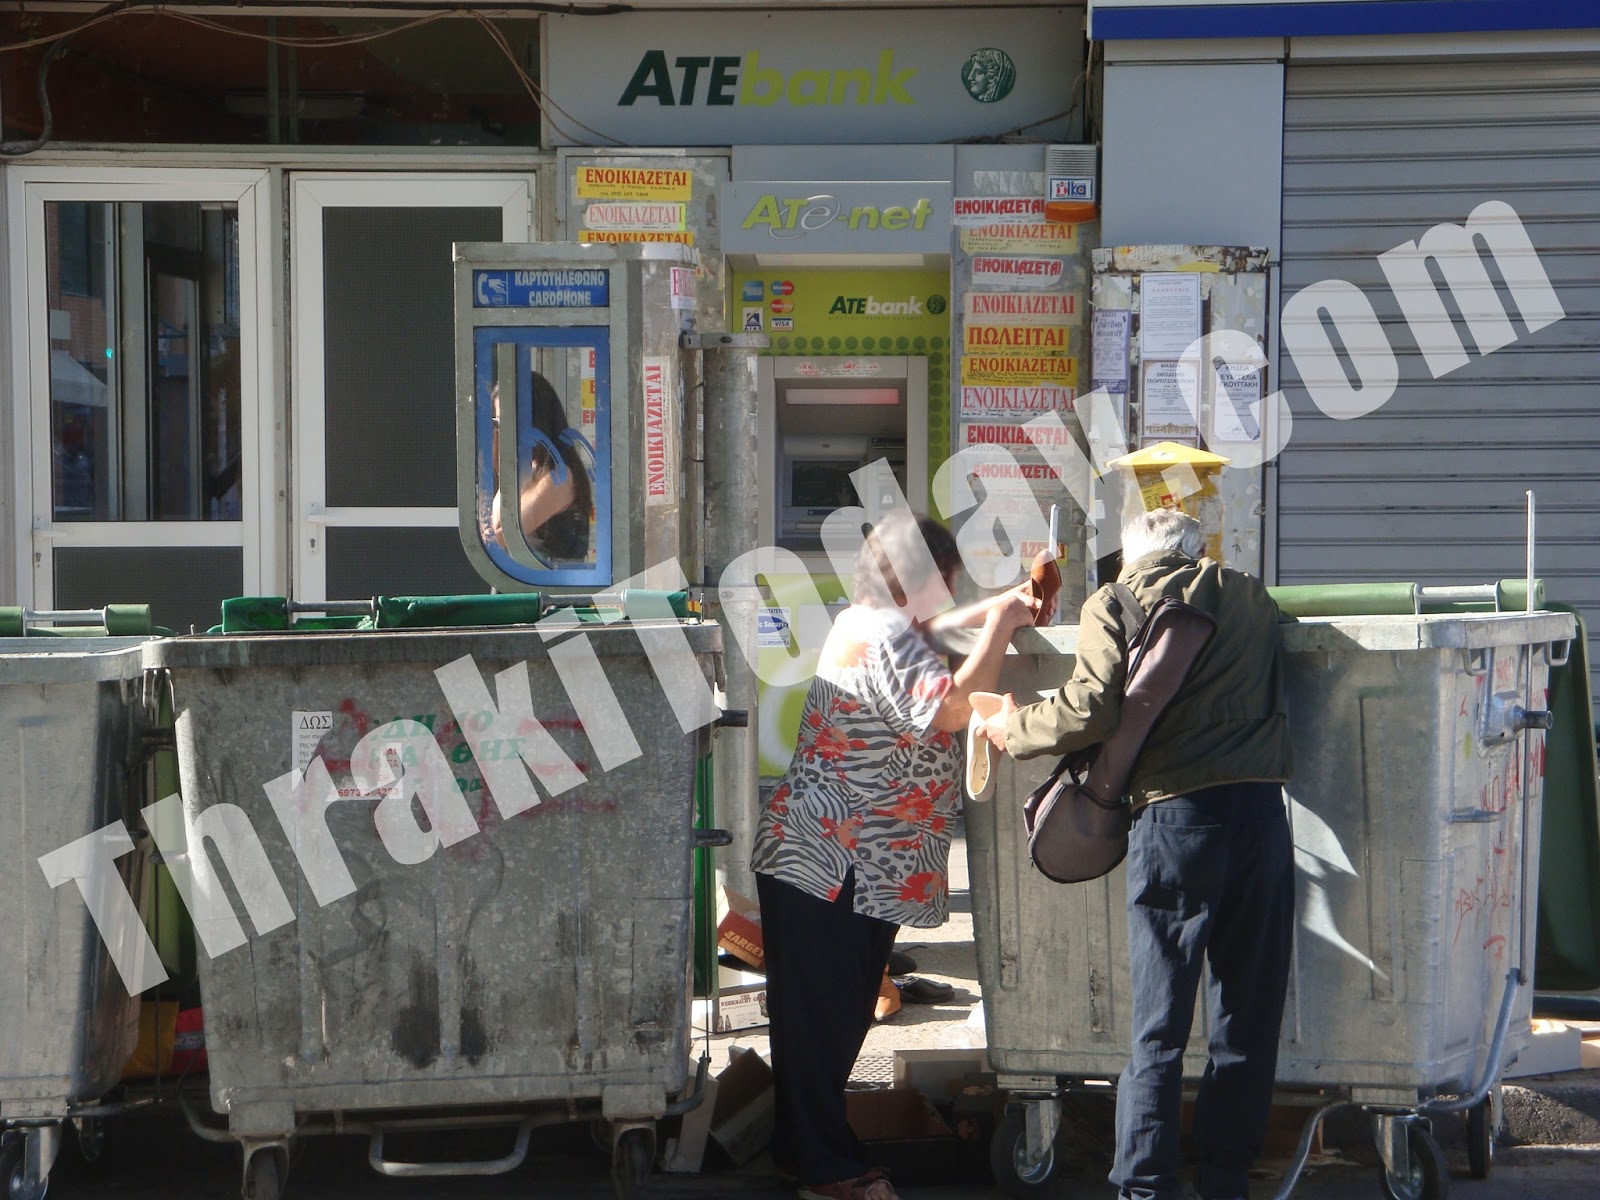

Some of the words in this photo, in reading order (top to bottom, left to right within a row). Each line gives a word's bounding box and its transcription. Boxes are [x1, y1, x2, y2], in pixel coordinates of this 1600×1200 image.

[617, 49, 917, 106] ATEbank
[585, 169, 687, 186] ΕΝΟΙΚΙΑΖΕΤΑΙ
[589, 205, 676, 223] ΕΝΟΙΚΙΑΖΕΤΑΙ
[954, 199, 1045, 215] ΕΝΟΙΚΙΑΖΕΤΑΙ
[973, 258, 1062, 275] ΕΝΟΙΚΙΑΖΕΤΑΙ
[515, 271, 605, 286] ΚΑΡΤΟΤΗΛΕΦΩΝΟ
[529, 291, 591, 306] CARDPHONE
[829, 295, 923, 315] ATEbank
[972, 295, 1075, 314] ΕΝΟΙΚΙΑΖΕΤΑΙ
[968, 327, 1064, 346] ΠΩΛΕΙΤΑΙ
[969, 358, 1073, 373] ΕΝΟΙΚΙΑΖΕΤΑΙ
[963, 387, 1076, 409] ΕΝΟΙΚΙΑΖΕΤΑΙ
[646, 364, 666, 496] ΕΝΟΙΚΙΑΖΕΤΑΙ
[967, 425, 1068, 445] ΕΝΟΙΚΙΑΖΕΤΑΙ
[972, 463, 1062, 480] ΕΝΟΙΚΙΑΖΕΤΑΙ
